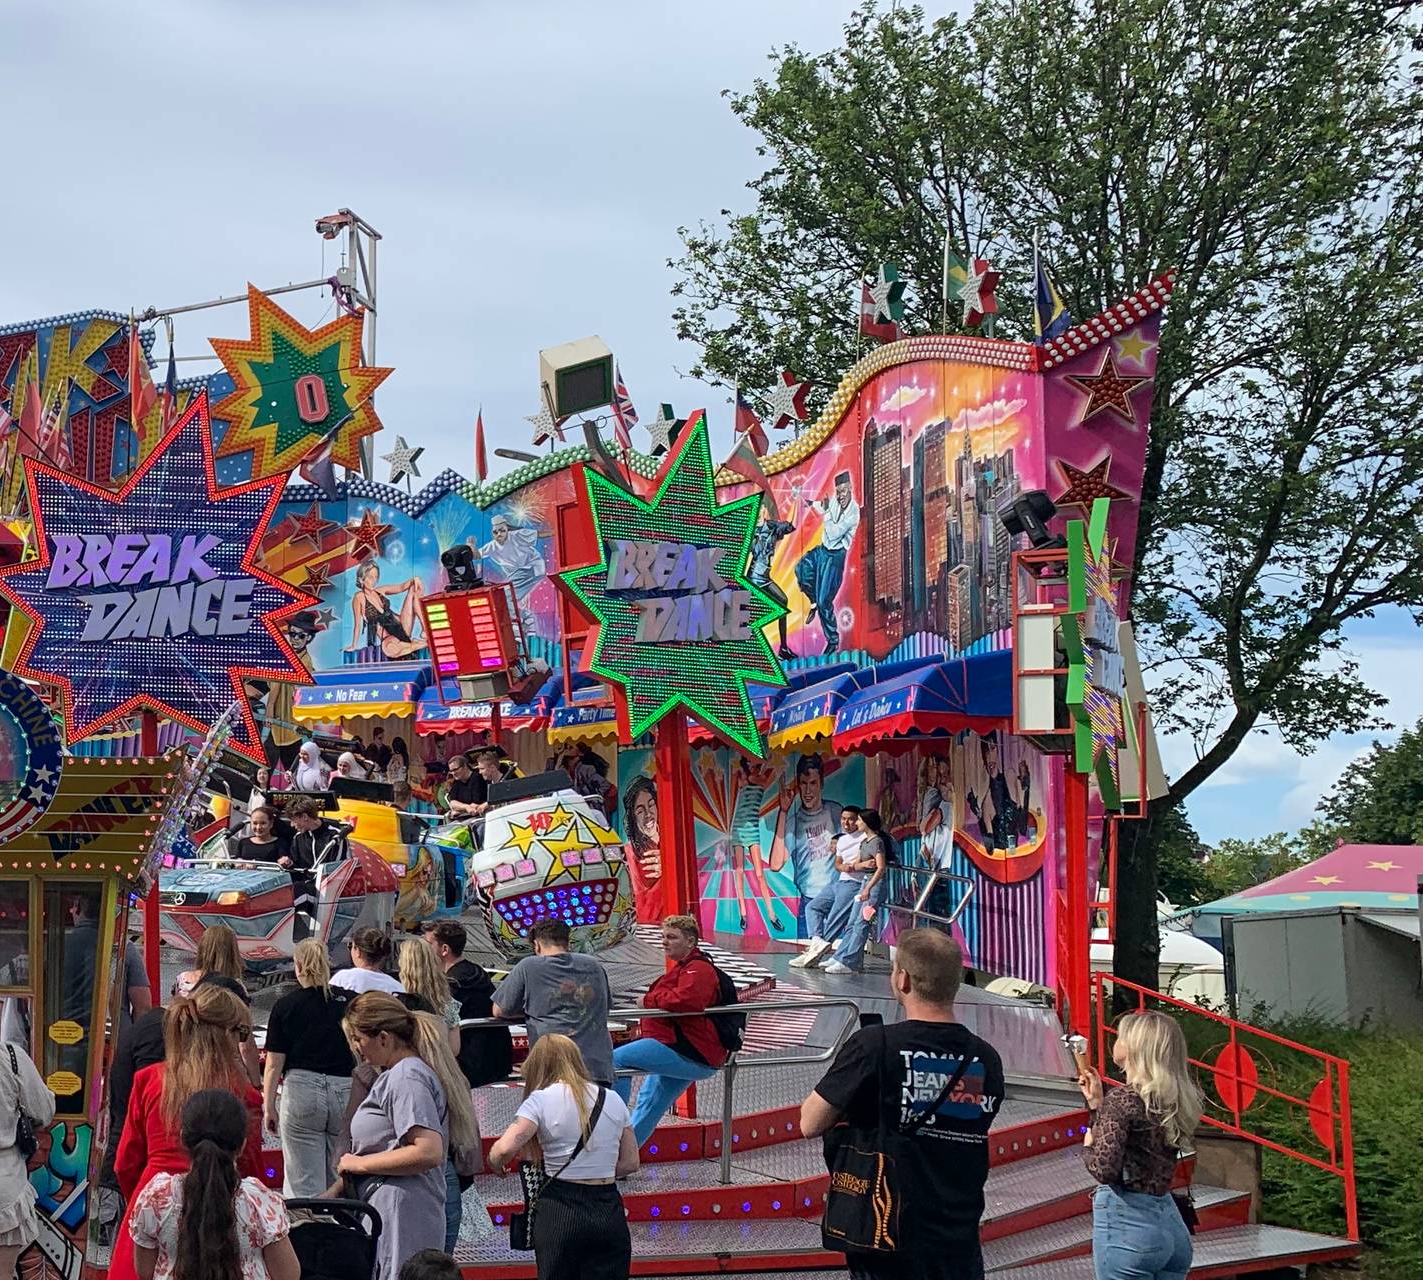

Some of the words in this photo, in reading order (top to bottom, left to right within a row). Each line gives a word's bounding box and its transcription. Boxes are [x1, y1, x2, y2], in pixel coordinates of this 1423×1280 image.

[45, 533, 224, 590] BREAK
[605, 539, 728, 595] BREAK
[77, 578, 257, 642] DANCE
[630, 588, 753, 643] DANCE
[335, 689, 347, 701] No
[348, 688, 368, 701] Fear
